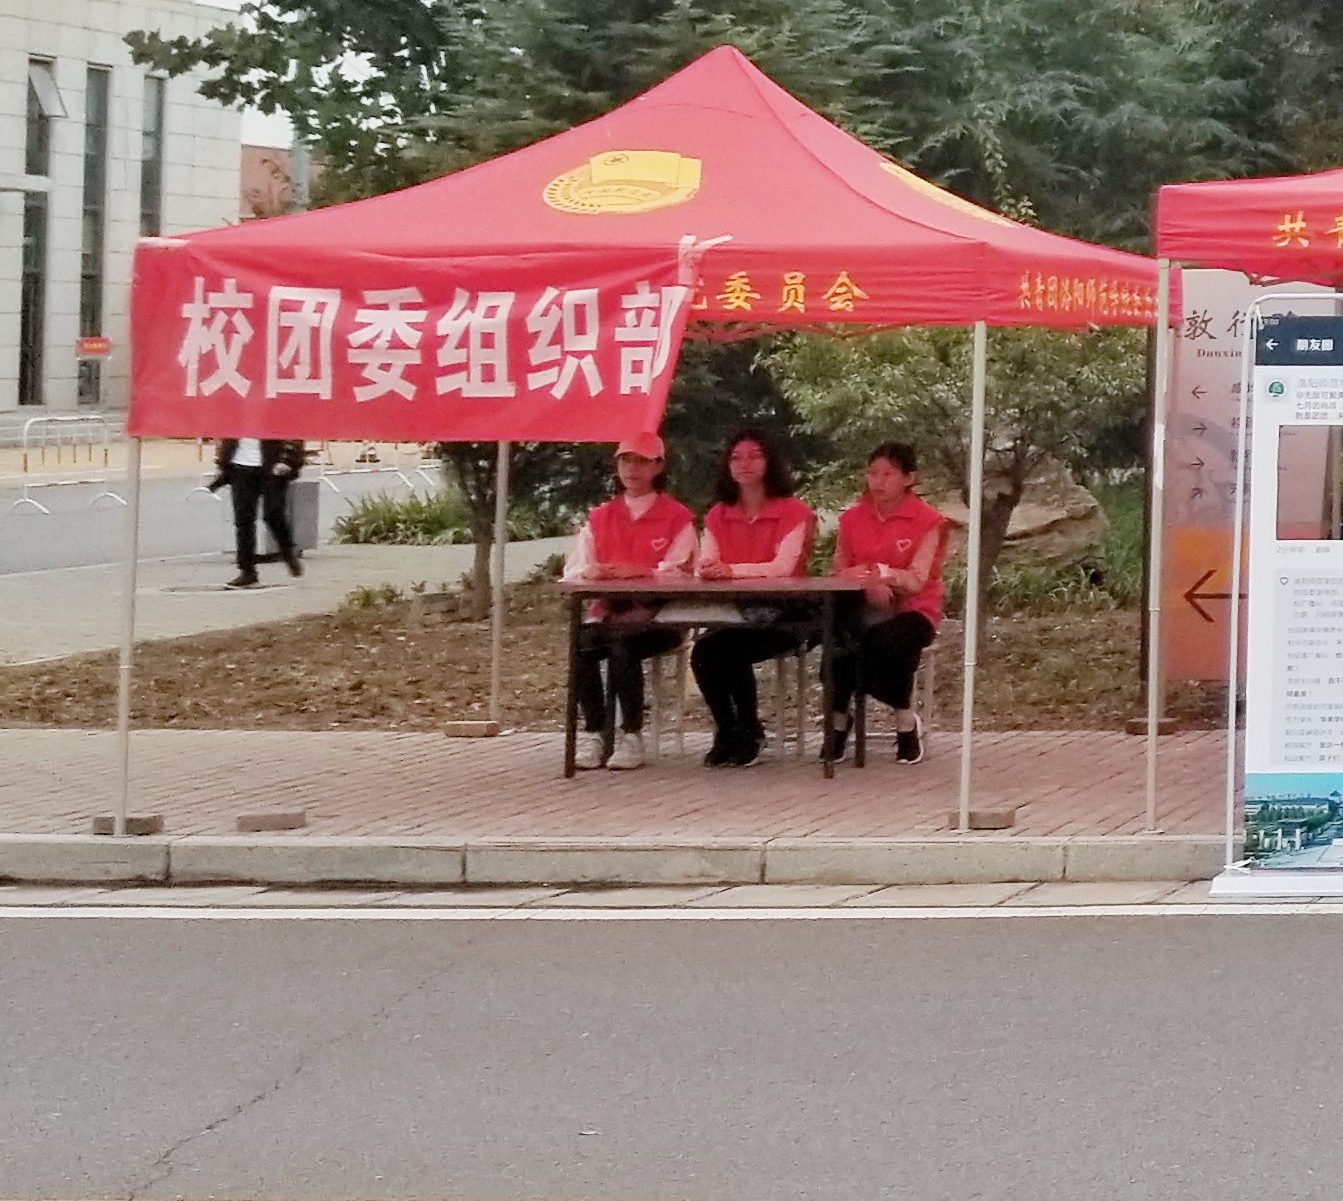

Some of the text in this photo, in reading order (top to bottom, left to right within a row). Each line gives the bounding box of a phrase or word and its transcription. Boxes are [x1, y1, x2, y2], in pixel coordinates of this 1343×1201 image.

[178, 277, 689, 401] 校团委组织部
[1296, 338, 1334, 352] 朋友圈
